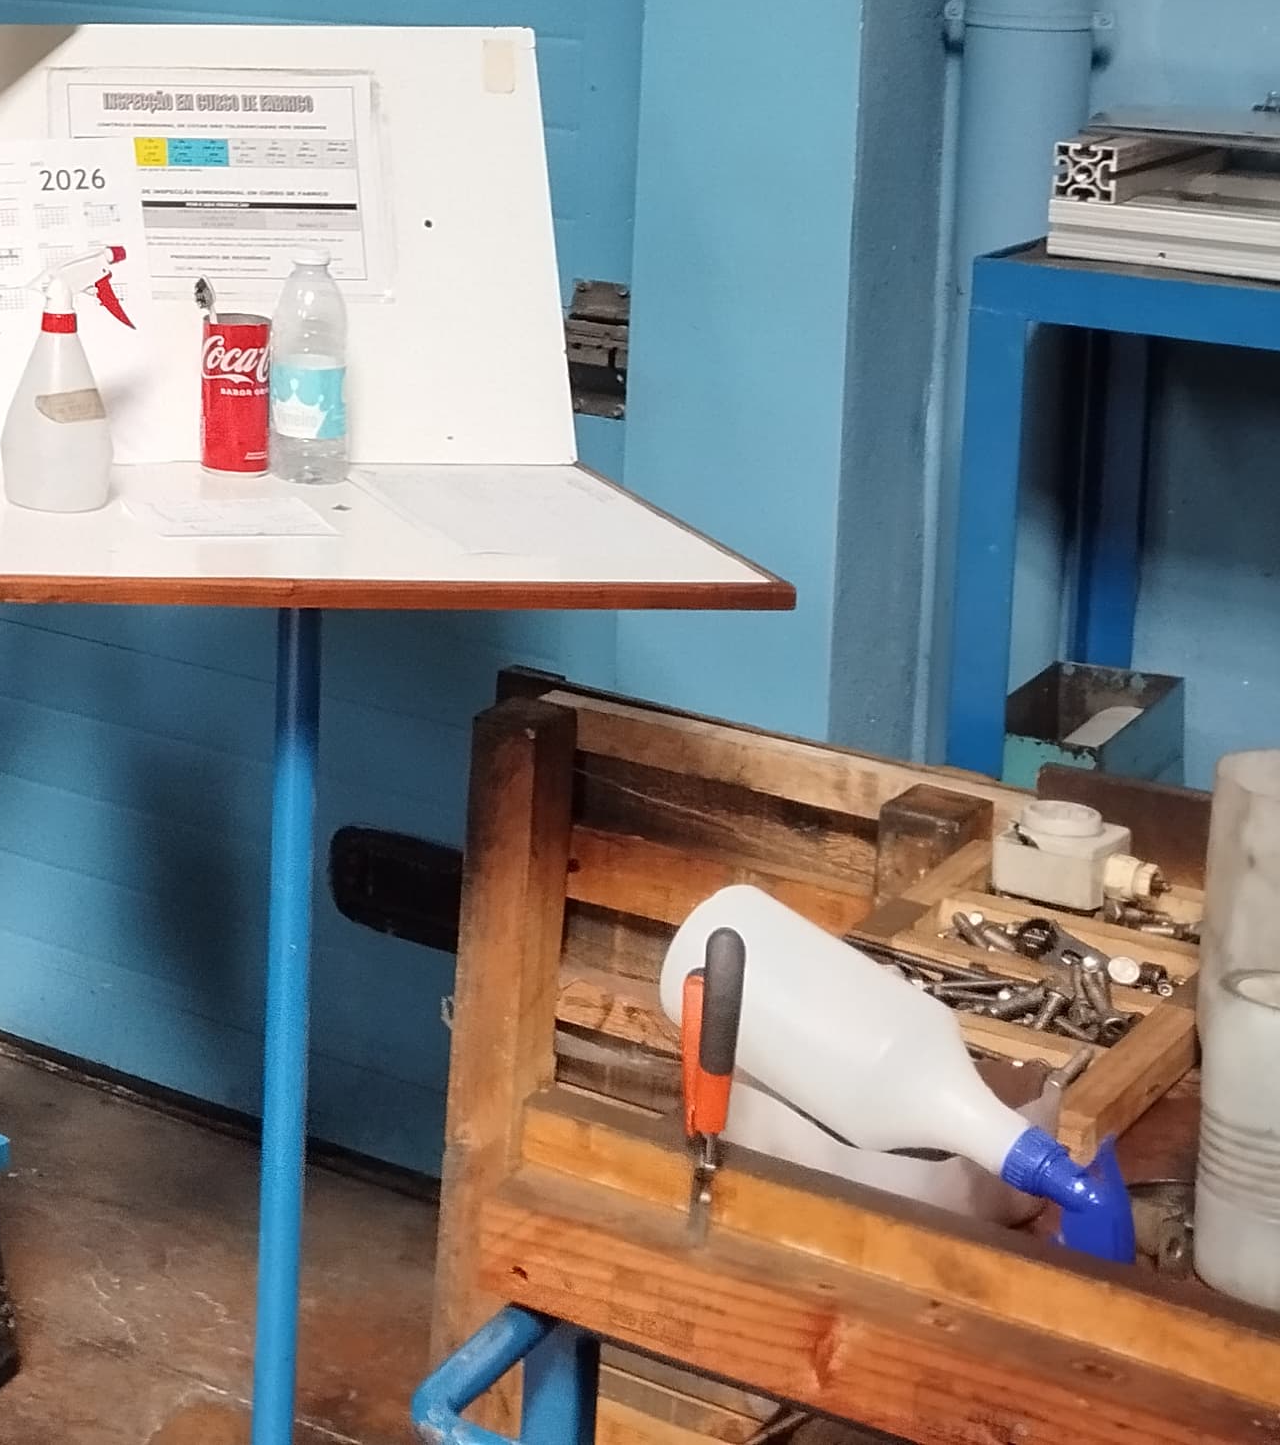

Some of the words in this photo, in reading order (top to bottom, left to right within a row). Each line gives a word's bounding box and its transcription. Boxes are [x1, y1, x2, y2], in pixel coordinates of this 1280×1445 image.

[175, 92, 194, 112] EM
[197, 93, 239, 112] CURSO
[242, 94, 259, 112] DE
[260, 94, 314, 113] FABRICO
[39, 168, 106, 191] 2026
